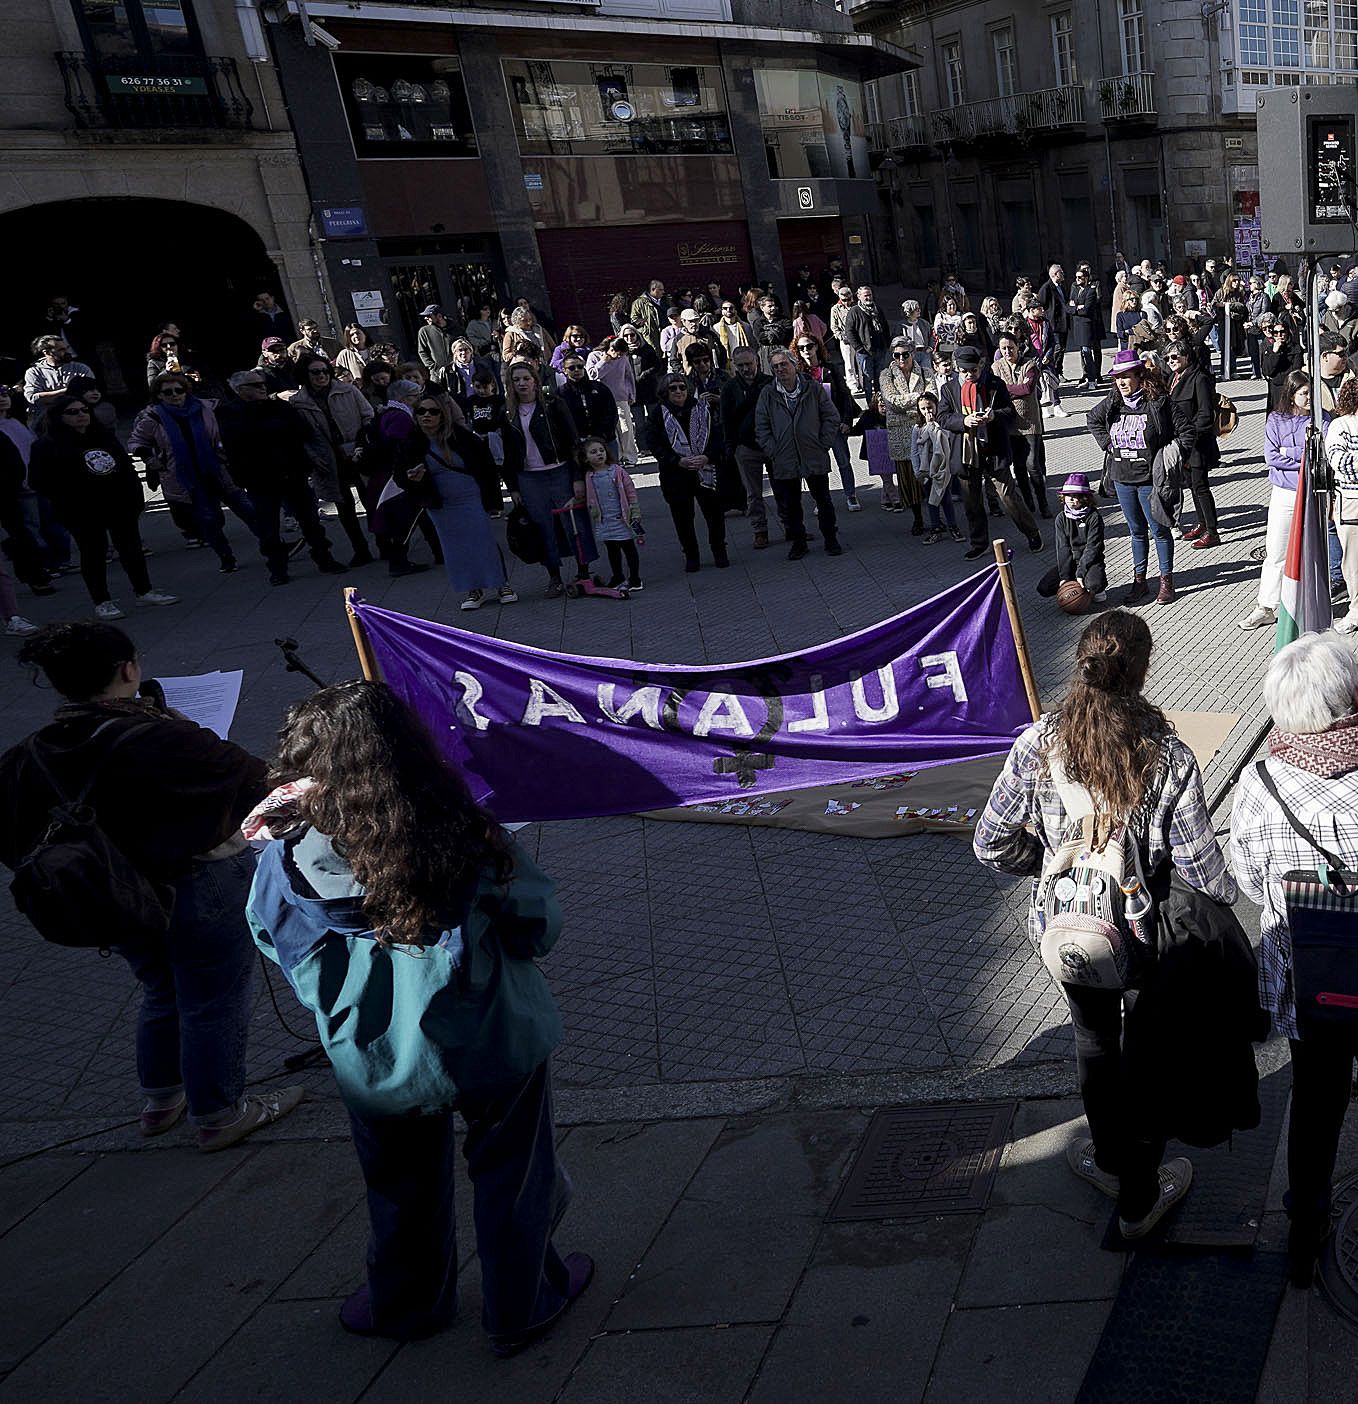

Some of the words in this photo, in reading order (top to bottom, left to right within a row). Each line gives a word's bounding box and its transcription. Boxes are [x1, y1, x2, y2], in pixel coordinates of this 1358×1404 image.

[120, 77, 141, 86] 626
[143, 78, 154, 86] 77
[157, 78, 170, 86] 36
[172, 78, 183, 87] 31
